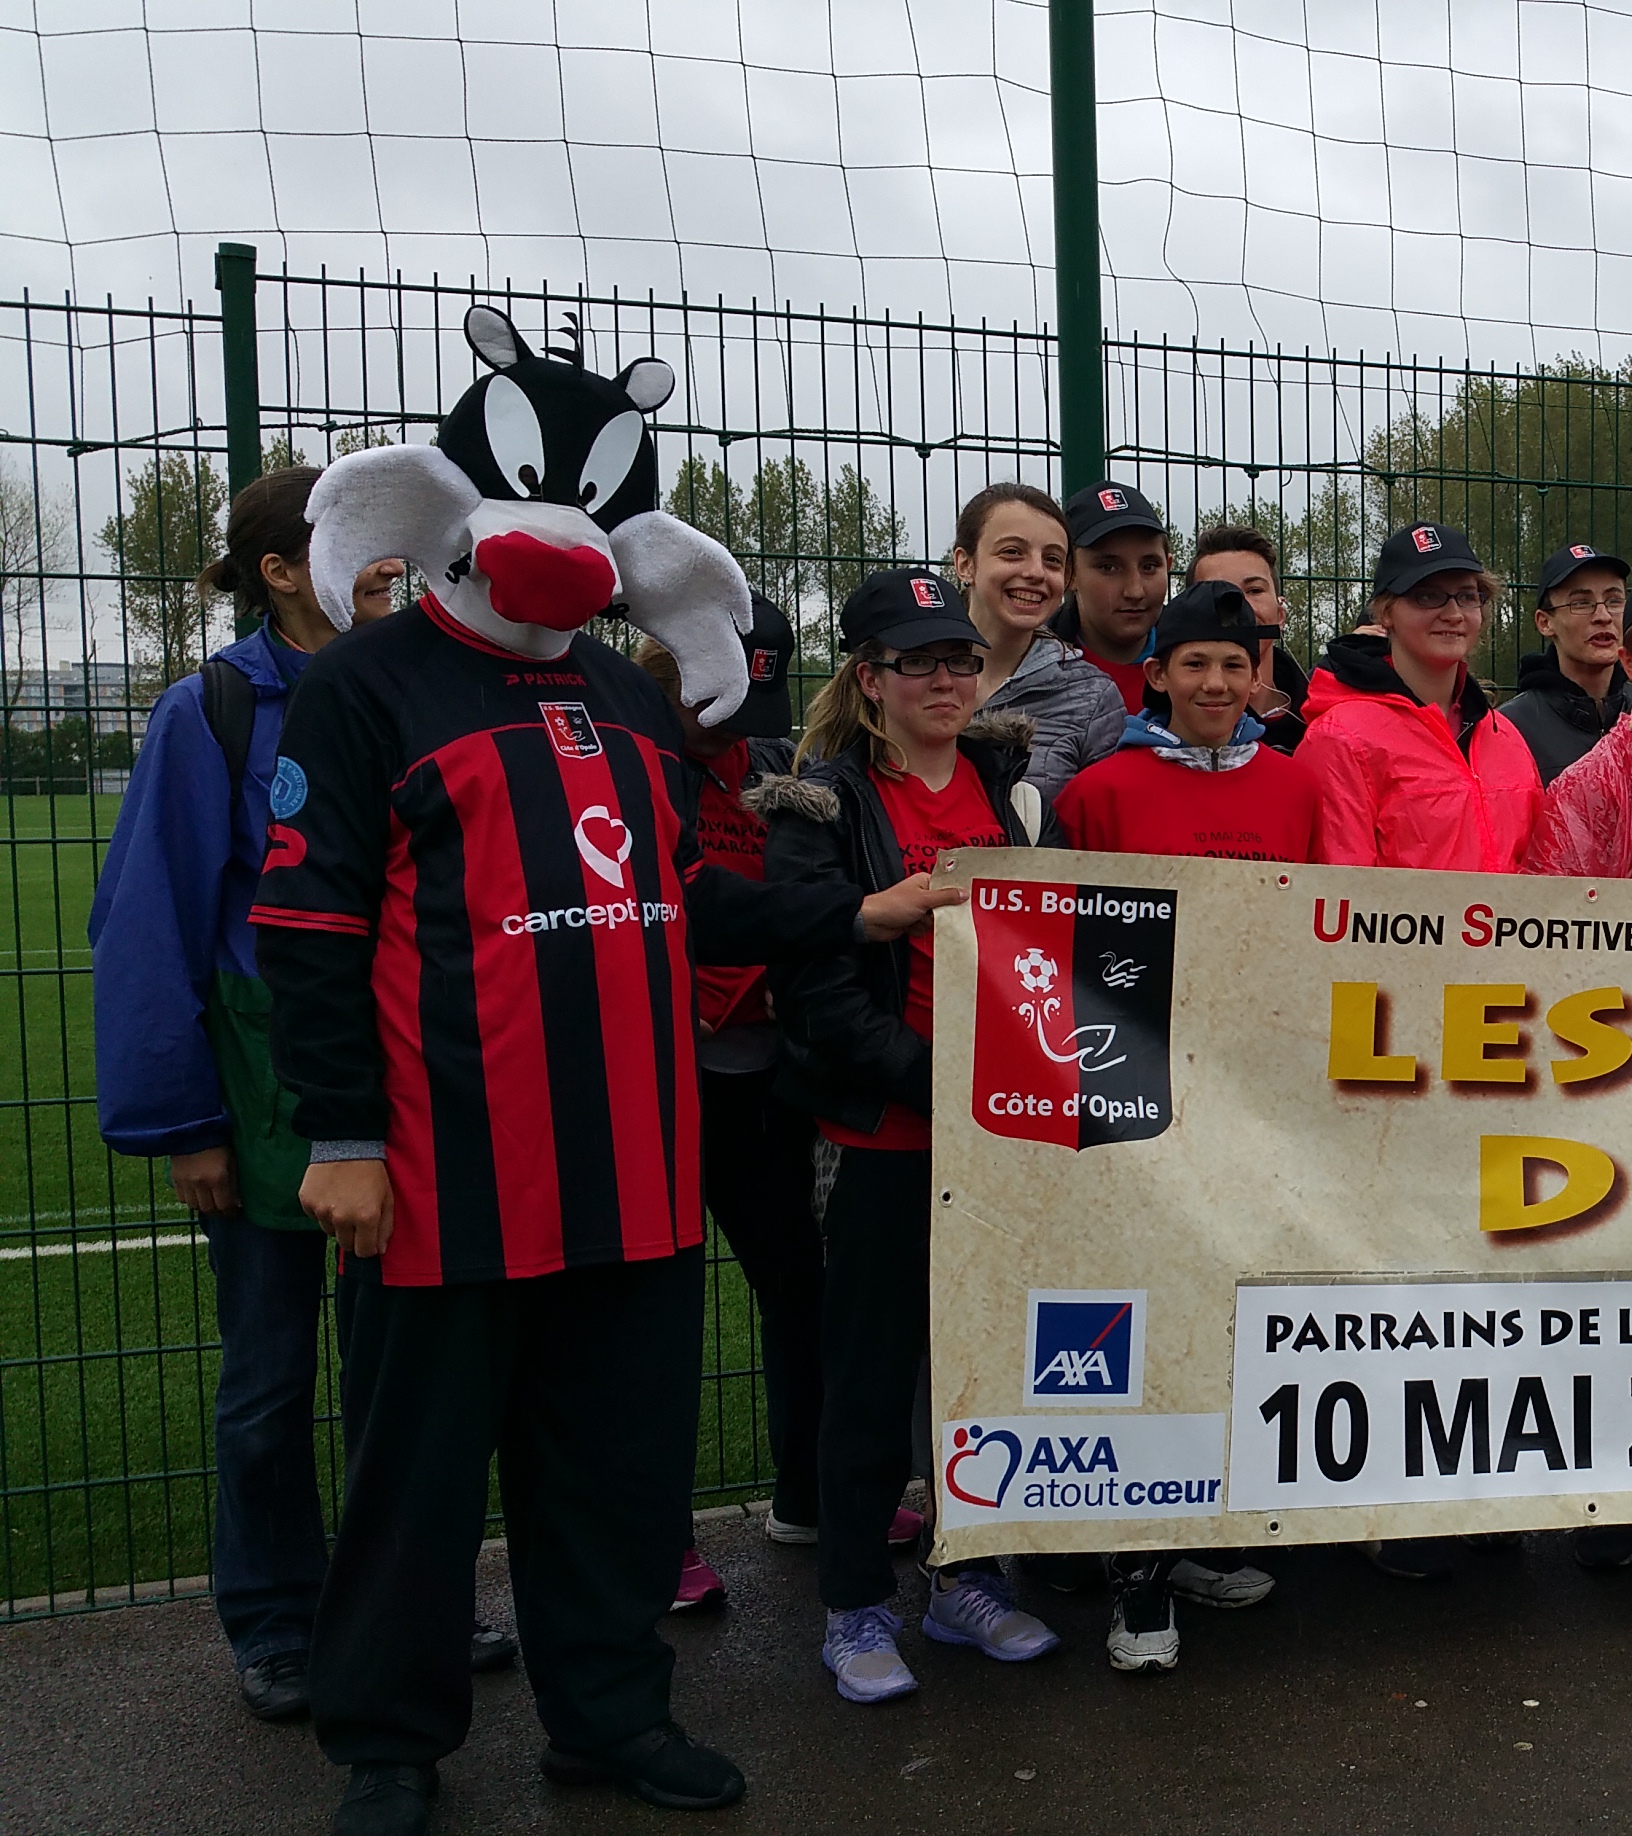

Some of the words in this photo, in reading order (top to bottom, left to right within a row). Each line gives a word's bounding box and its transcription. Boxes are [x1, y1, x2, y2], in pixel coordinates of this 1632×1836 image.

[524, 672, 587, 686] PATRICK
[699, 816, 768, 850] OLYMPIA
[702, 838, 766, 856] MARGA
[502, 898, 640, 936] carcept
[642, 902, 679, 928] prev
[979, 888, 1031, 912] U.S.
[1041, 891, 1172, 924] Boulogne
[987, 1091, 1057, 1119] Côte
[1061, 1092, 1160, 1123] d'Opale
[1265, 1307, 1523, 1354] PARRAINS
[1539, 1308, 1600, 1347] DE
[1034, 1350, 1112, 1388] AXA
[1259, 1379, 1370, 1485] 10
[1404, 1374, 1593, 1478] MAI
[1025, 1436, 1120, 1475] AXA
[1024, 1476, 1121, 1510] atout
[1125, 1475, 1222, 1506] cœur
